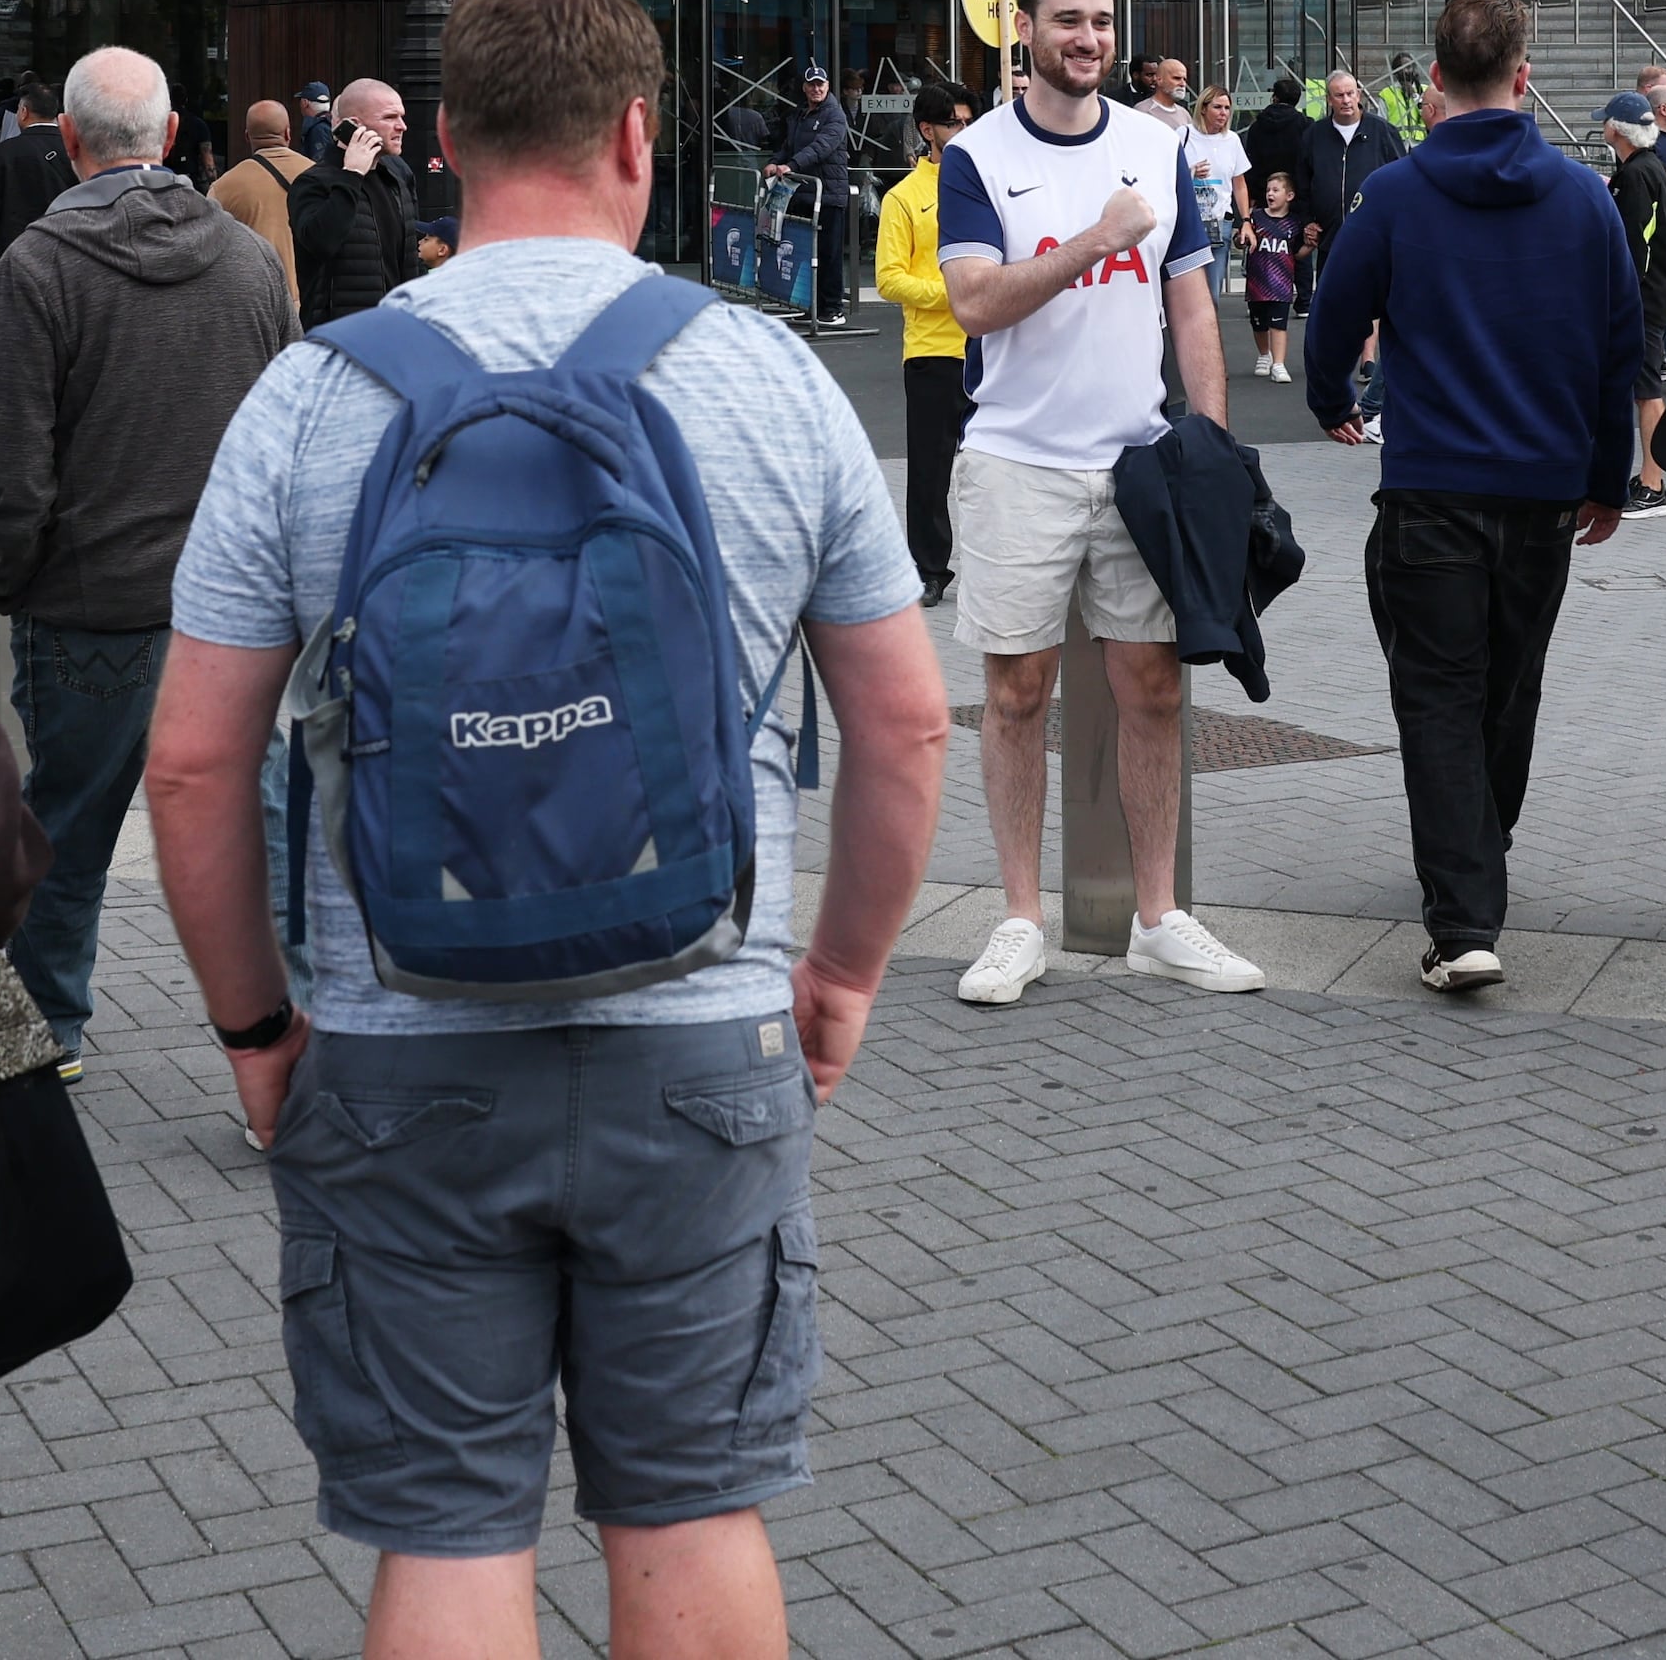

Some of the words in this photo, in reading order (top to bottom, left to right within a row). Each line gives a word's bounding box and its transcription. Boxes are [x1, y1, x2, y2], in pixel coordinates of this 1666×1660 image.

[868, 100, 895, 108] EXIT
[1237, 97, 1263, 106] EXIT
[1259, 238, 1289, 254] AIA
[451, 695, 613, 749] Kappa
